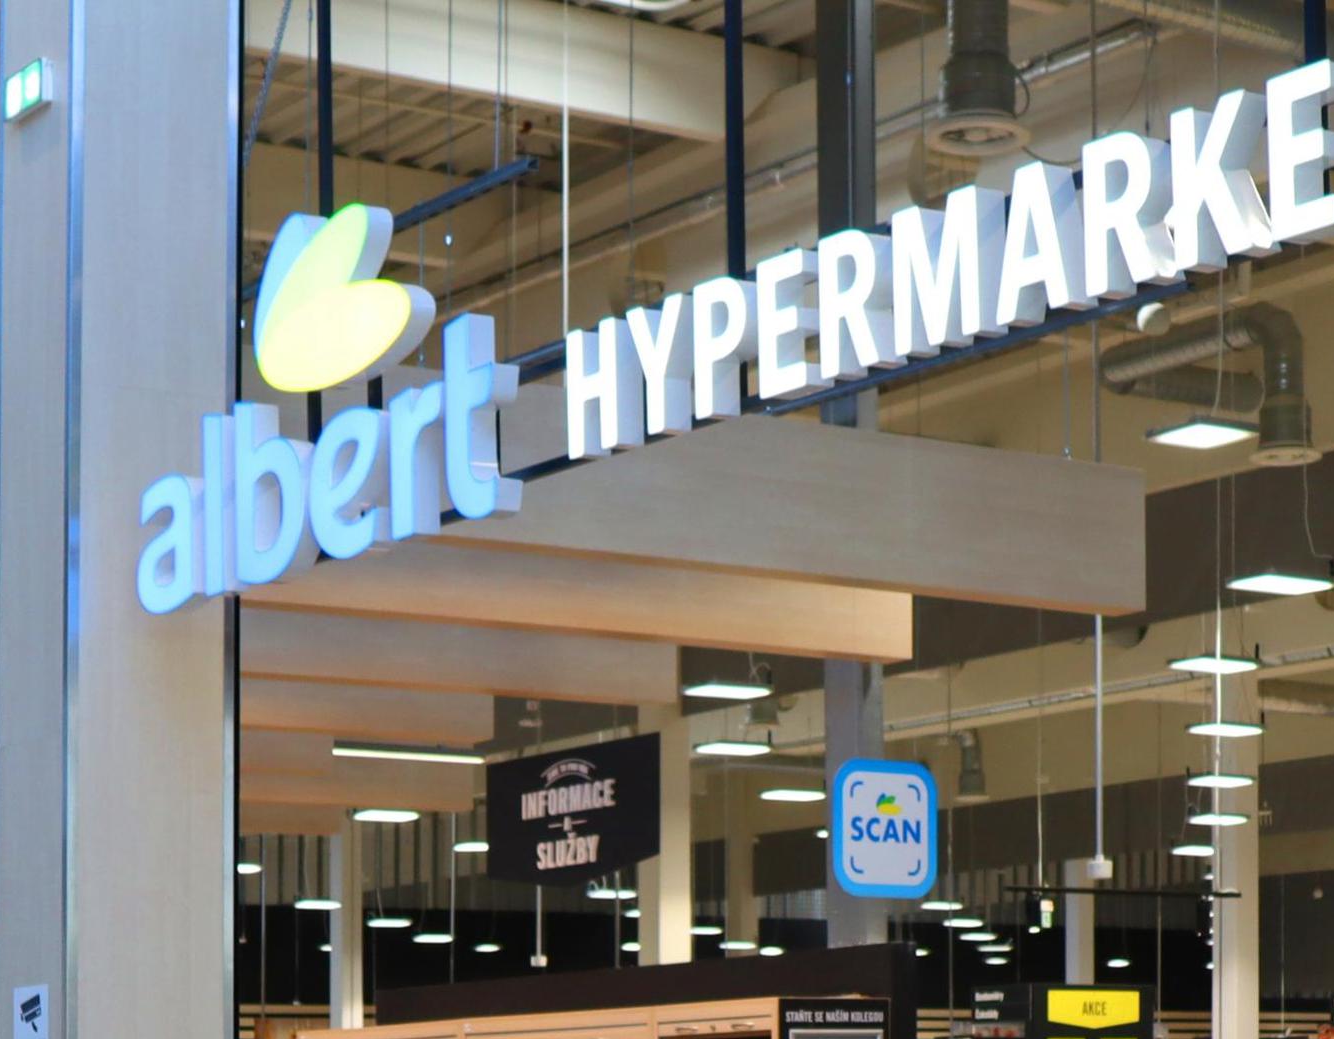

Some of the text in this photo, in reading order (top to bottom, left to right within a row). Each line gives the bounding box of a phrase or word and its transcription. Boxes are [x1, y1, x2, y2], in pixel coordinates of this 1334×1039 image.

[137, 312, 522, 615] albert
[521, 778, 615, 821] INFORMACE
[850, 816, 921, 844] SCAN
[536, 832, 600, 870] SLUŽBY
[814, 1011, 824, 1023] SE
[851, 1011, 884, 1024] KOLEGOU
[1082, 1001, 1107, 1016] AKCE
